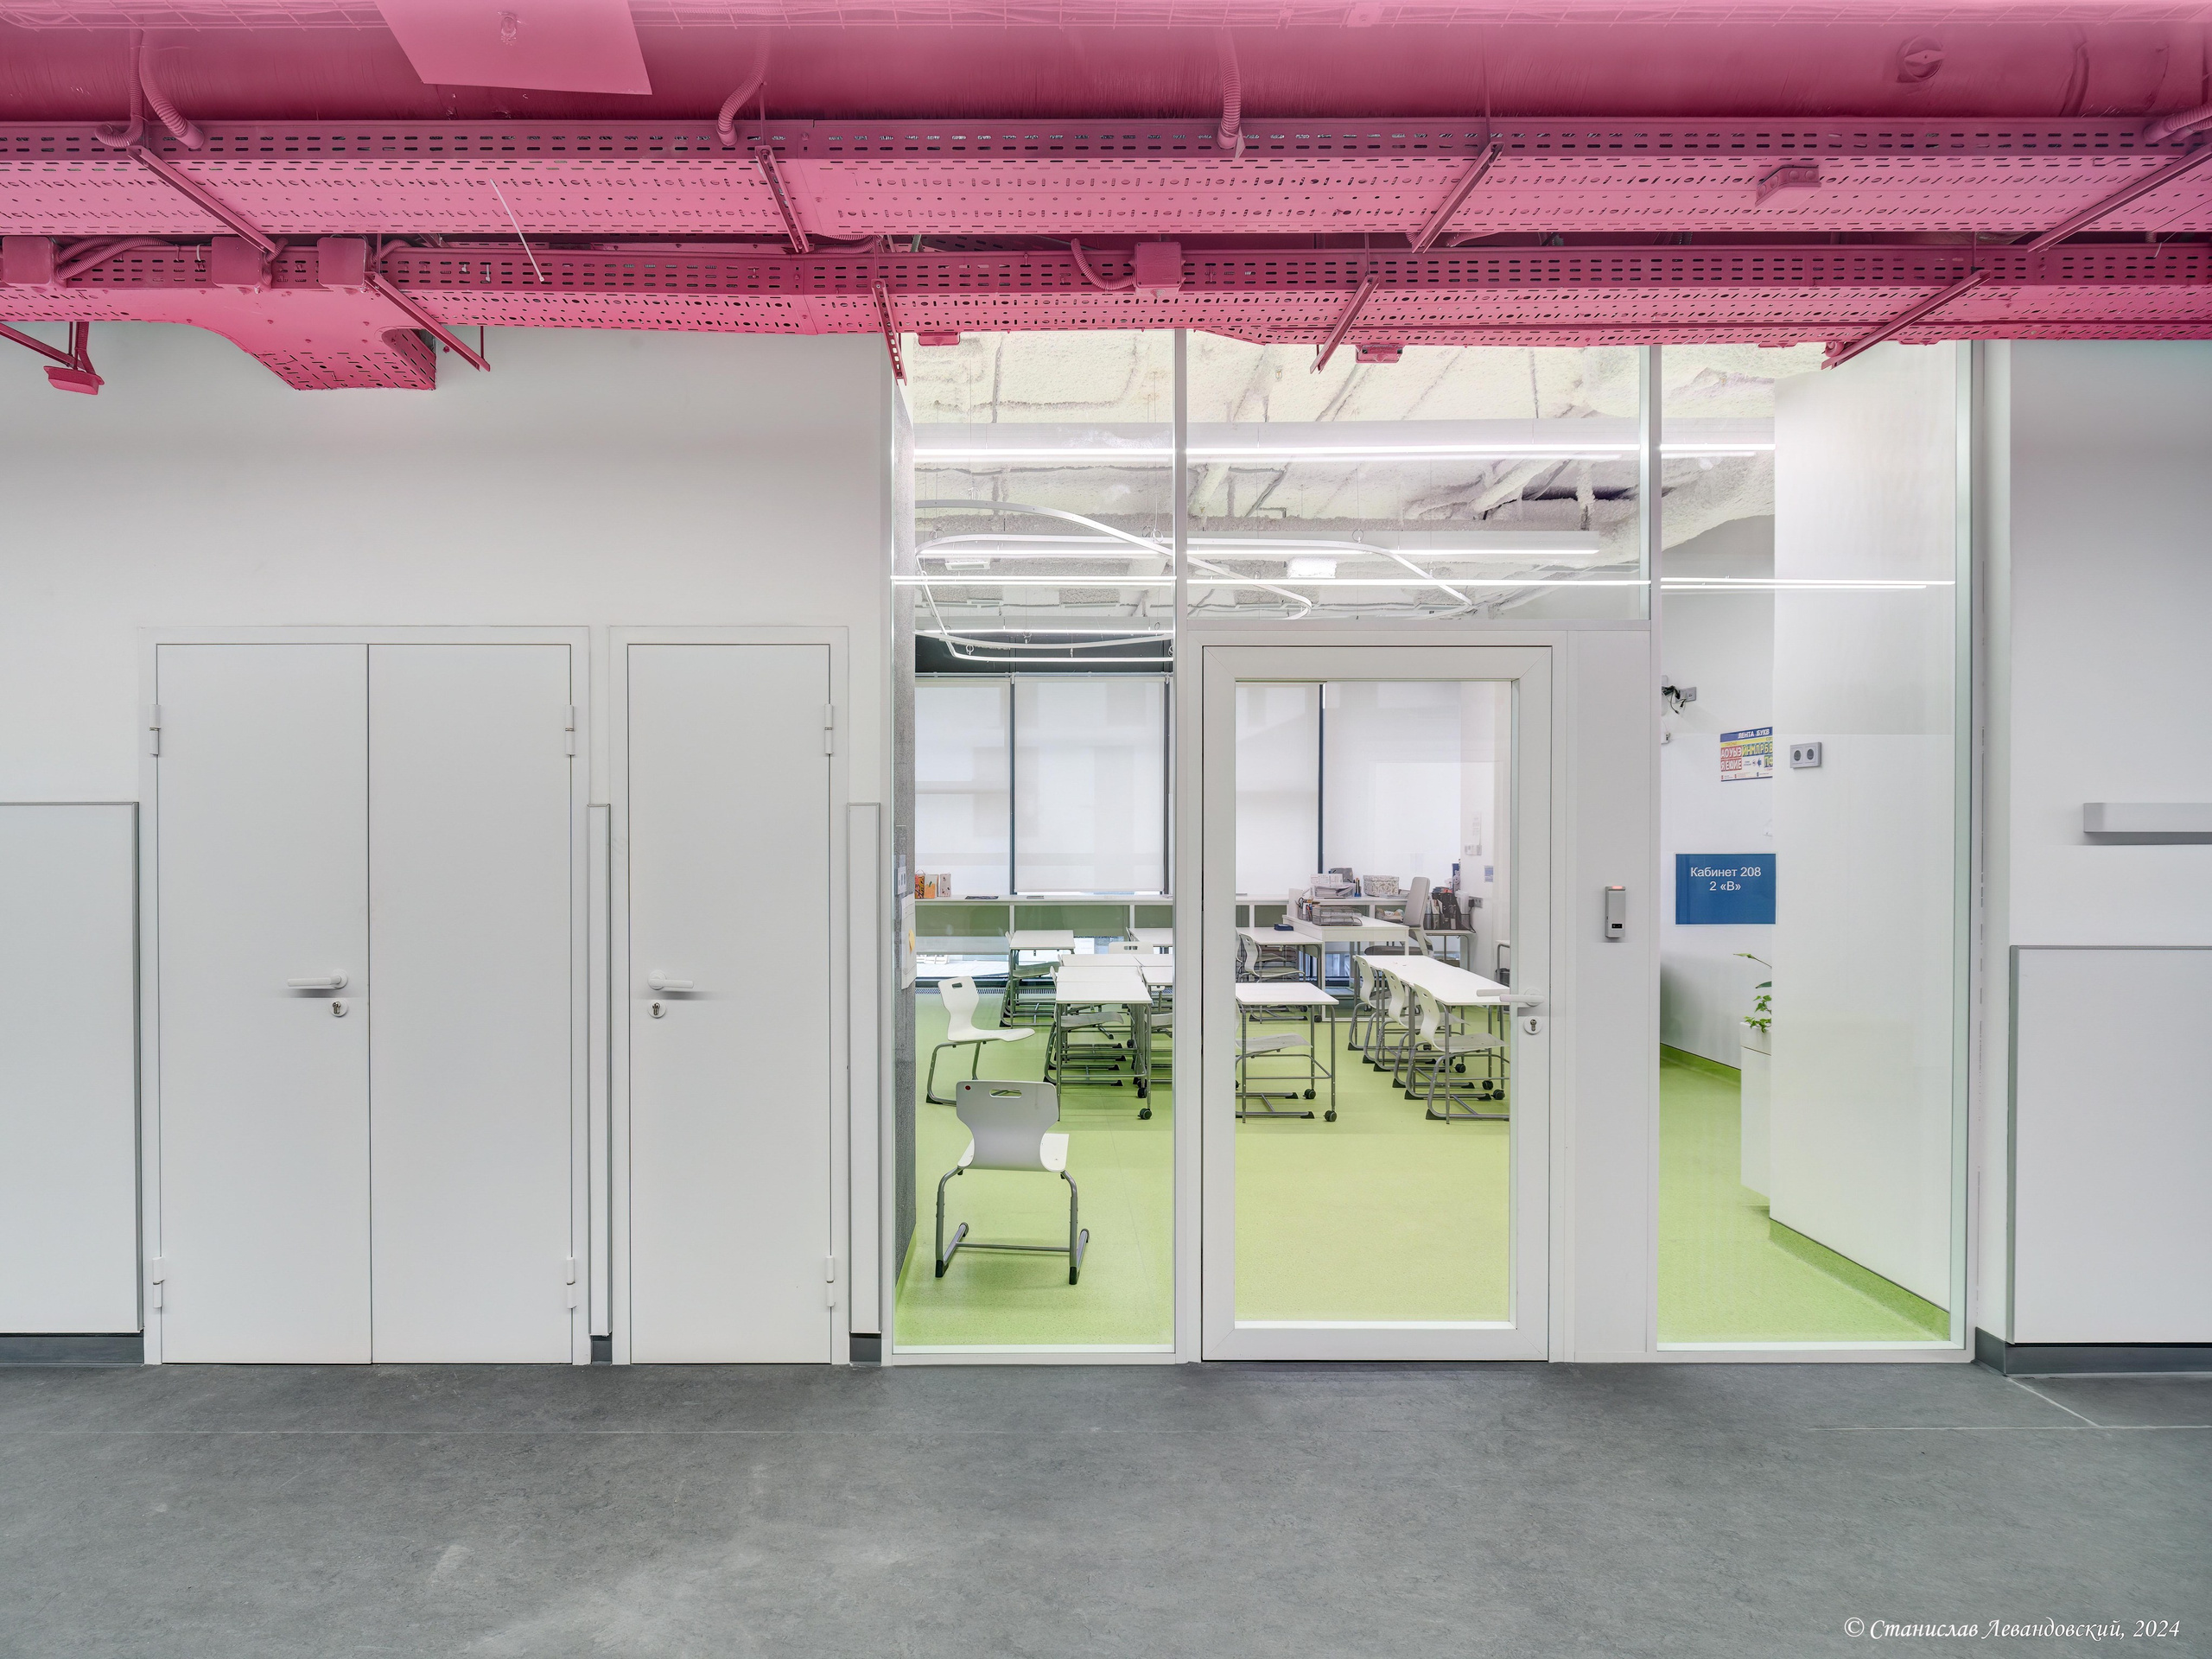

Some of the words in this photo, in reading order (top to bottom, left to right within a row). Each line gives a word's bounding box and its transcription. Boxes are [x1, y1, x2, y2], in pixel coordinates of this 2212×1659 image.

[1690, 867, 1738, 877] Кабинет
[1740, 867, 1761, 877] 208
[1709, 881, 1717, 891] 2
[1720, 880, 1742, 891] «В»
